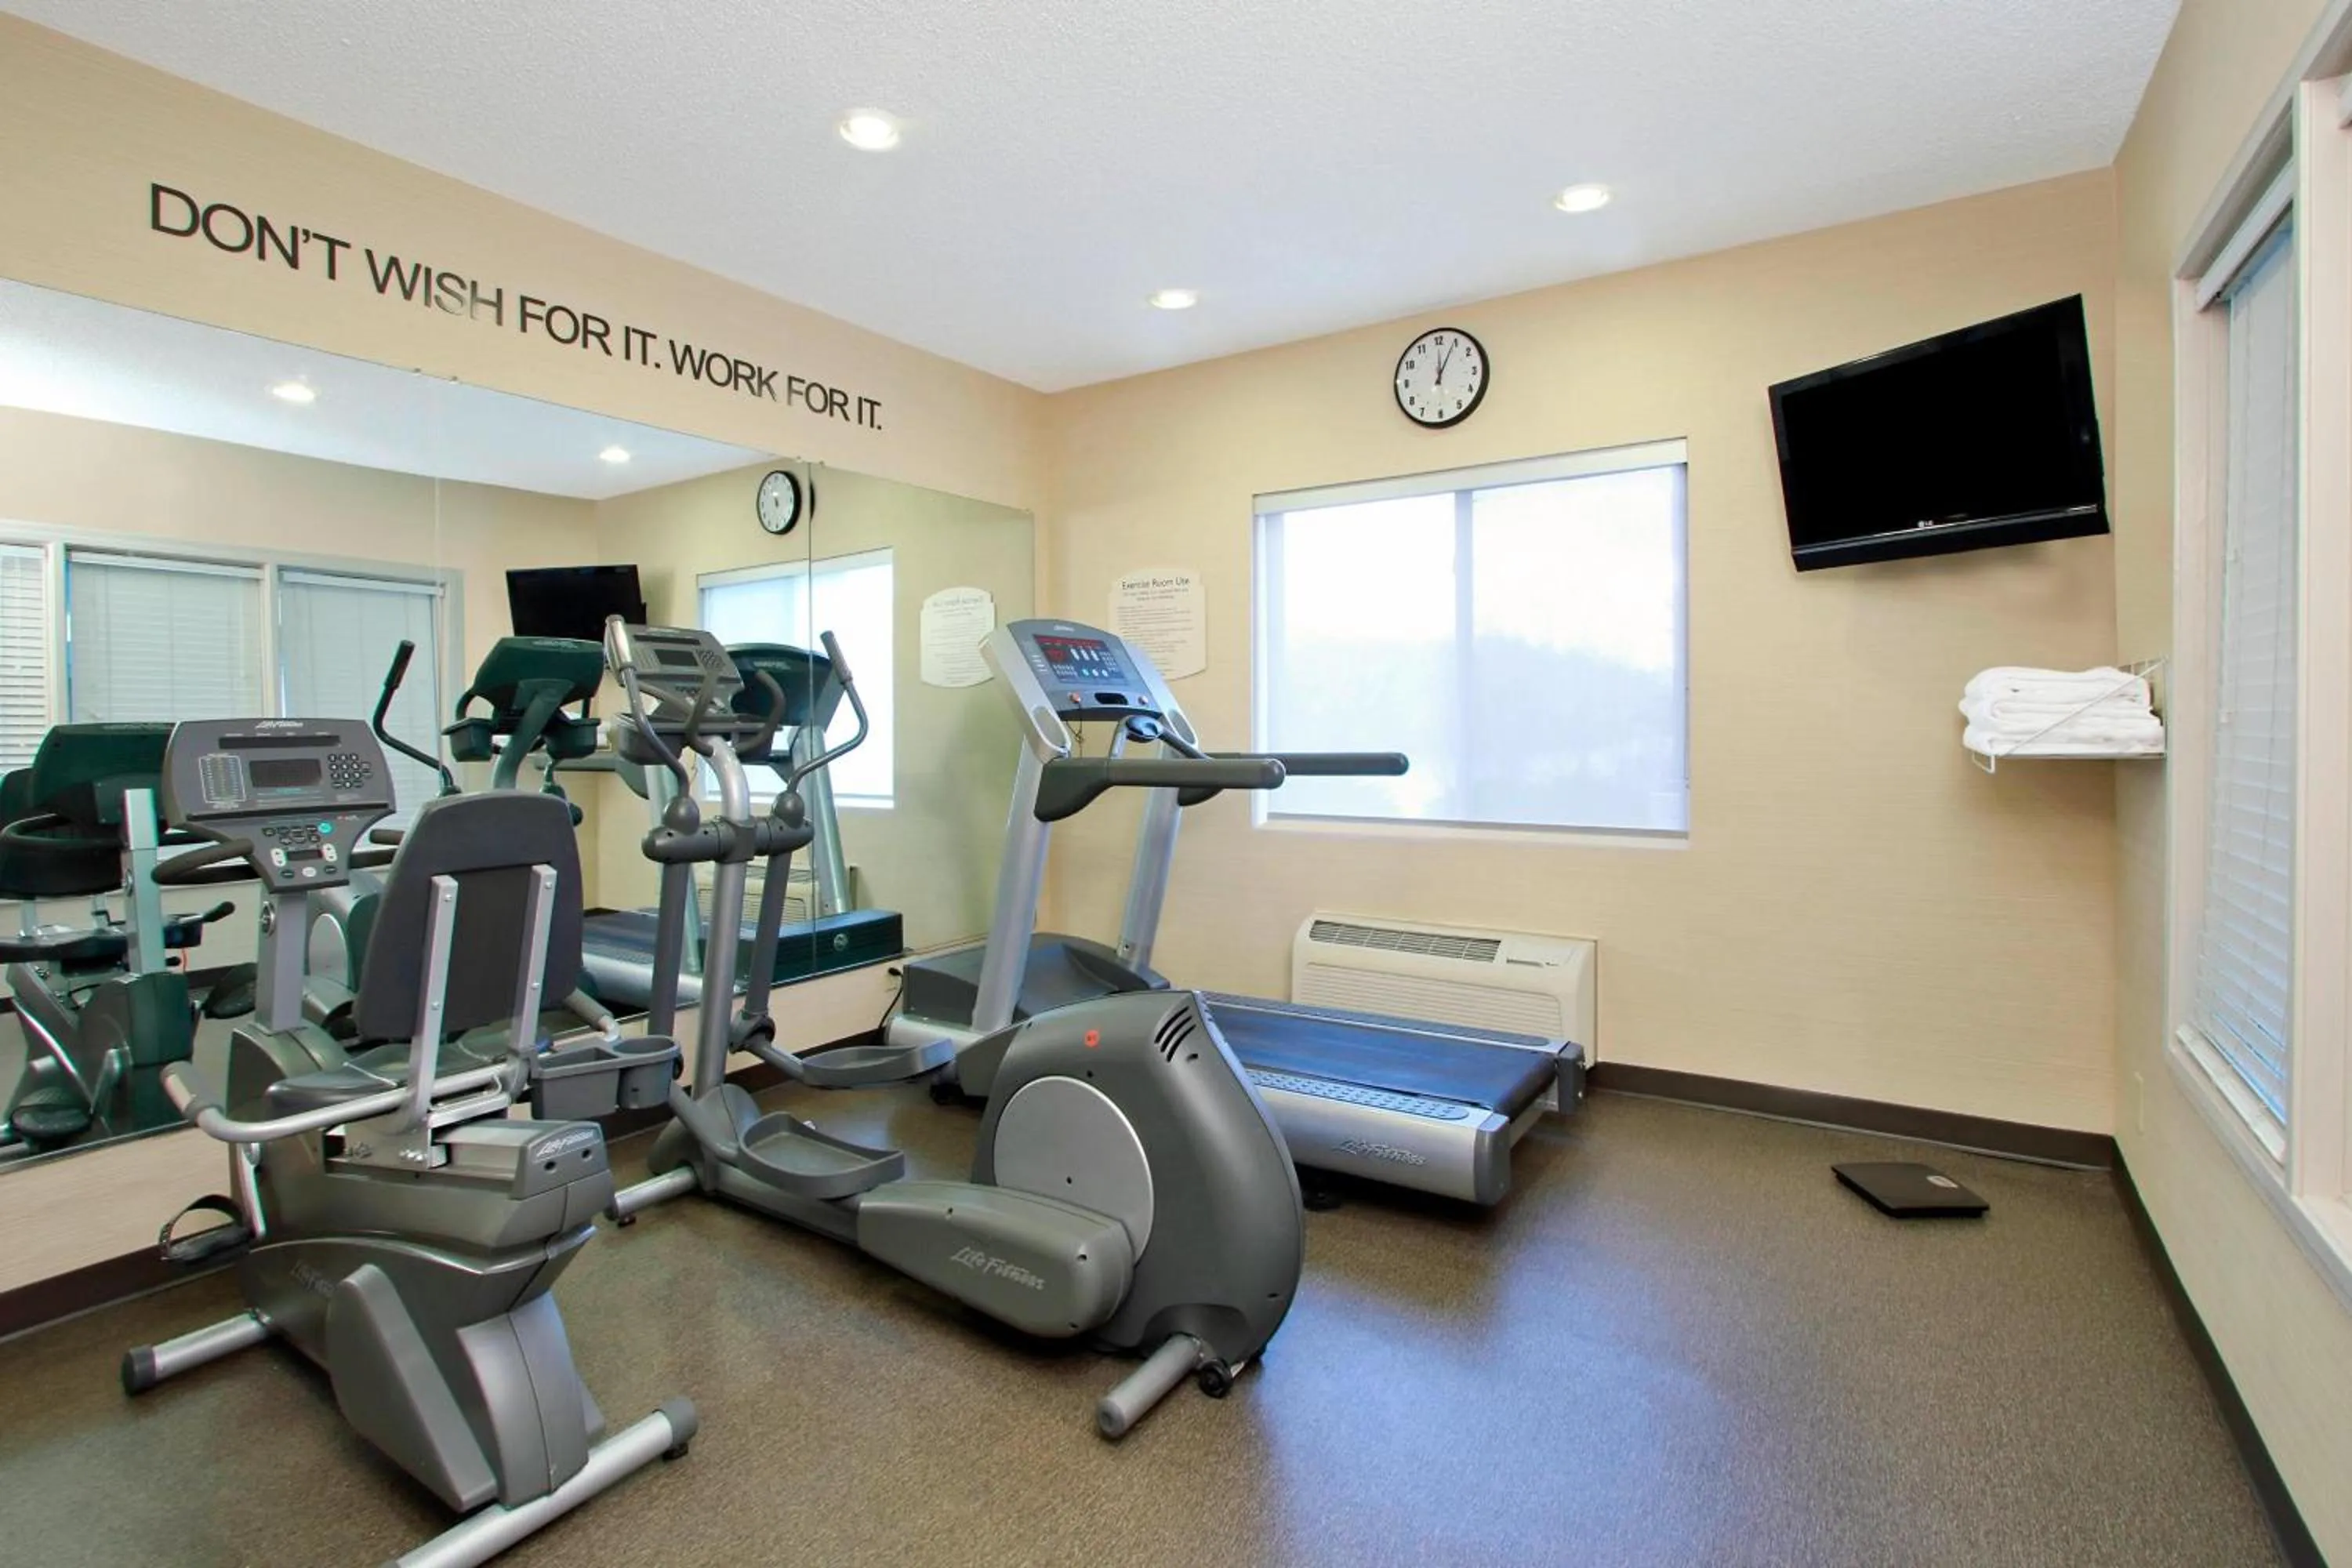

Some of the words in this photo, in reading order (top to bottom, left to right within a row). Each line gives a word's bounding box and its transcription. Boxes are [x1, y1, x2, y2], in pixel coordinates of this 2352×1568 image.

[365, 248, 503, 327] WISH
[519, 295, 612, 357] FOR
[624, 325, 661, 369] IT.
[668, 339, 779, 402] WORK
[787, 375, 851, 422] FOR
[857, 396, 884, 430] IT.
[1434, 335, 1443, 346] 12
[1417, 344, 1426, 354] 11
[1466, 347, 1472, 357] 2
[1405, 360, 1414, 371] 10
[1472, 366, 1477, 376] 3
[1409, 396, 1414, 405] 8
[1420, 407, 1425, 417] 7
[1152, 578, 1174, 587] Room
[951, 1246, 985, 1269] Life
[983, 1257, 1046, 1291] Fitness
